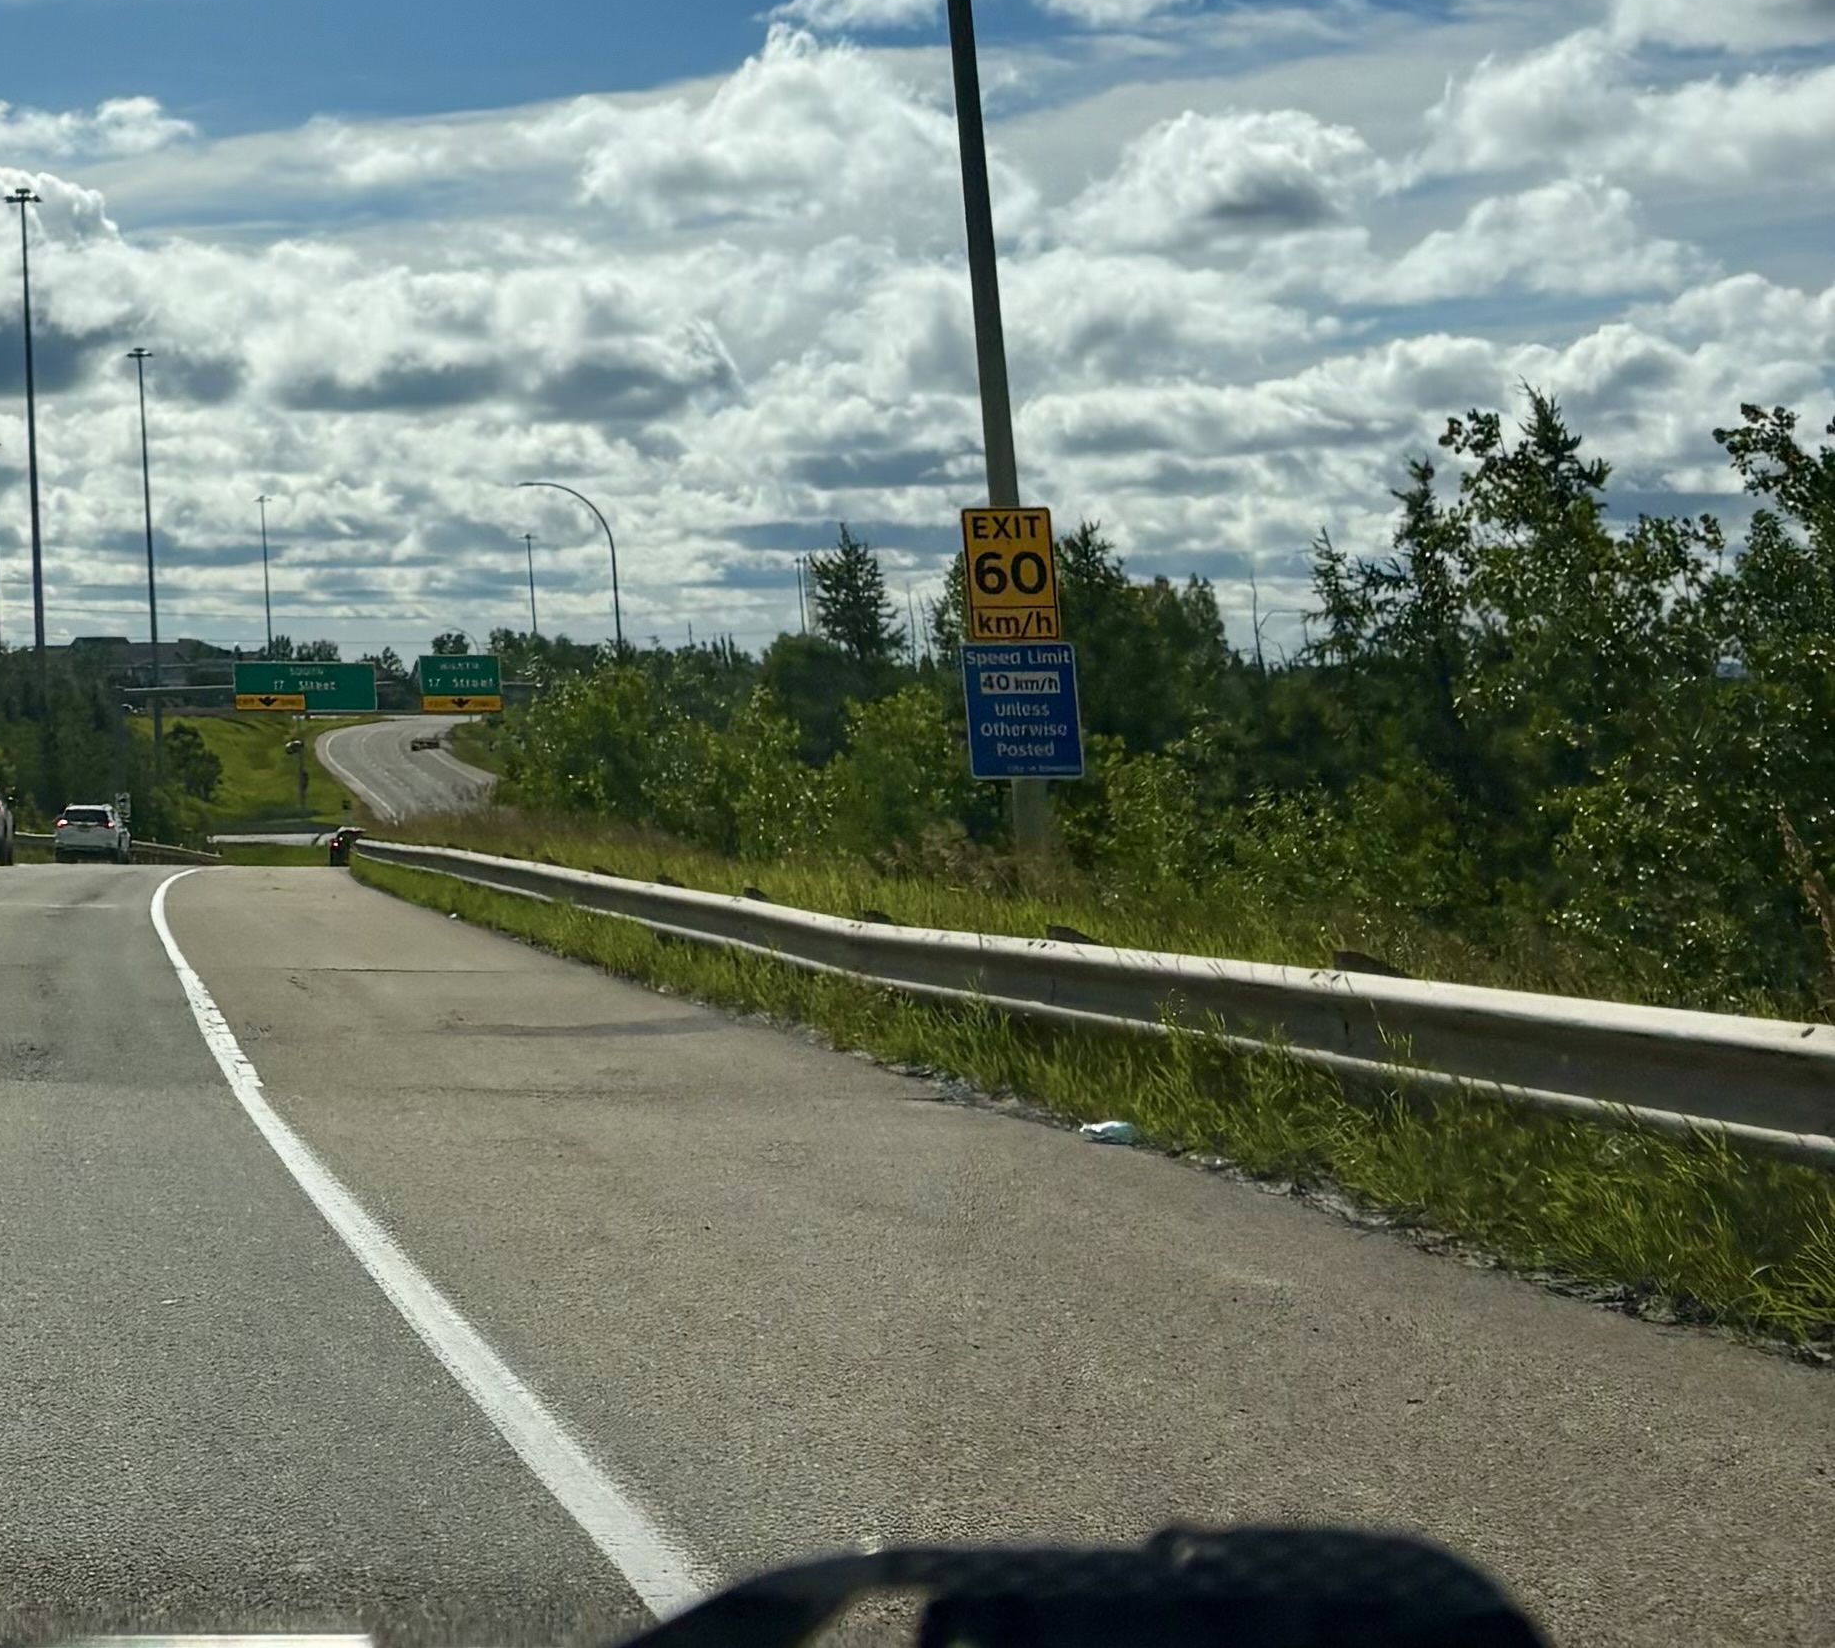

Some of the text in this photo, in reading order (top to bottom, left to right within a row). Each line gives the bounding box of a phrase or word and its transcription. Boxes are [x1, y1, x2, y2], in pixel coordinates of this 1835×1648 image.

[972, 516, 1040, 540] EXIT
[975, 551, 1047, 594] 60
[978, 610, 1052, 636] km/h
[966, 649, 1071, 667] Speed Limit
[273, 680, 285, 691] 17
[428, 678, 441, 688] 17
[982, 674, 1058, 692] 40 km/h
[994, 702, 1050, 717] Unless
[980, 721, 1068, 737] Otherwise
[996, 741, 1055, 757] Posted
